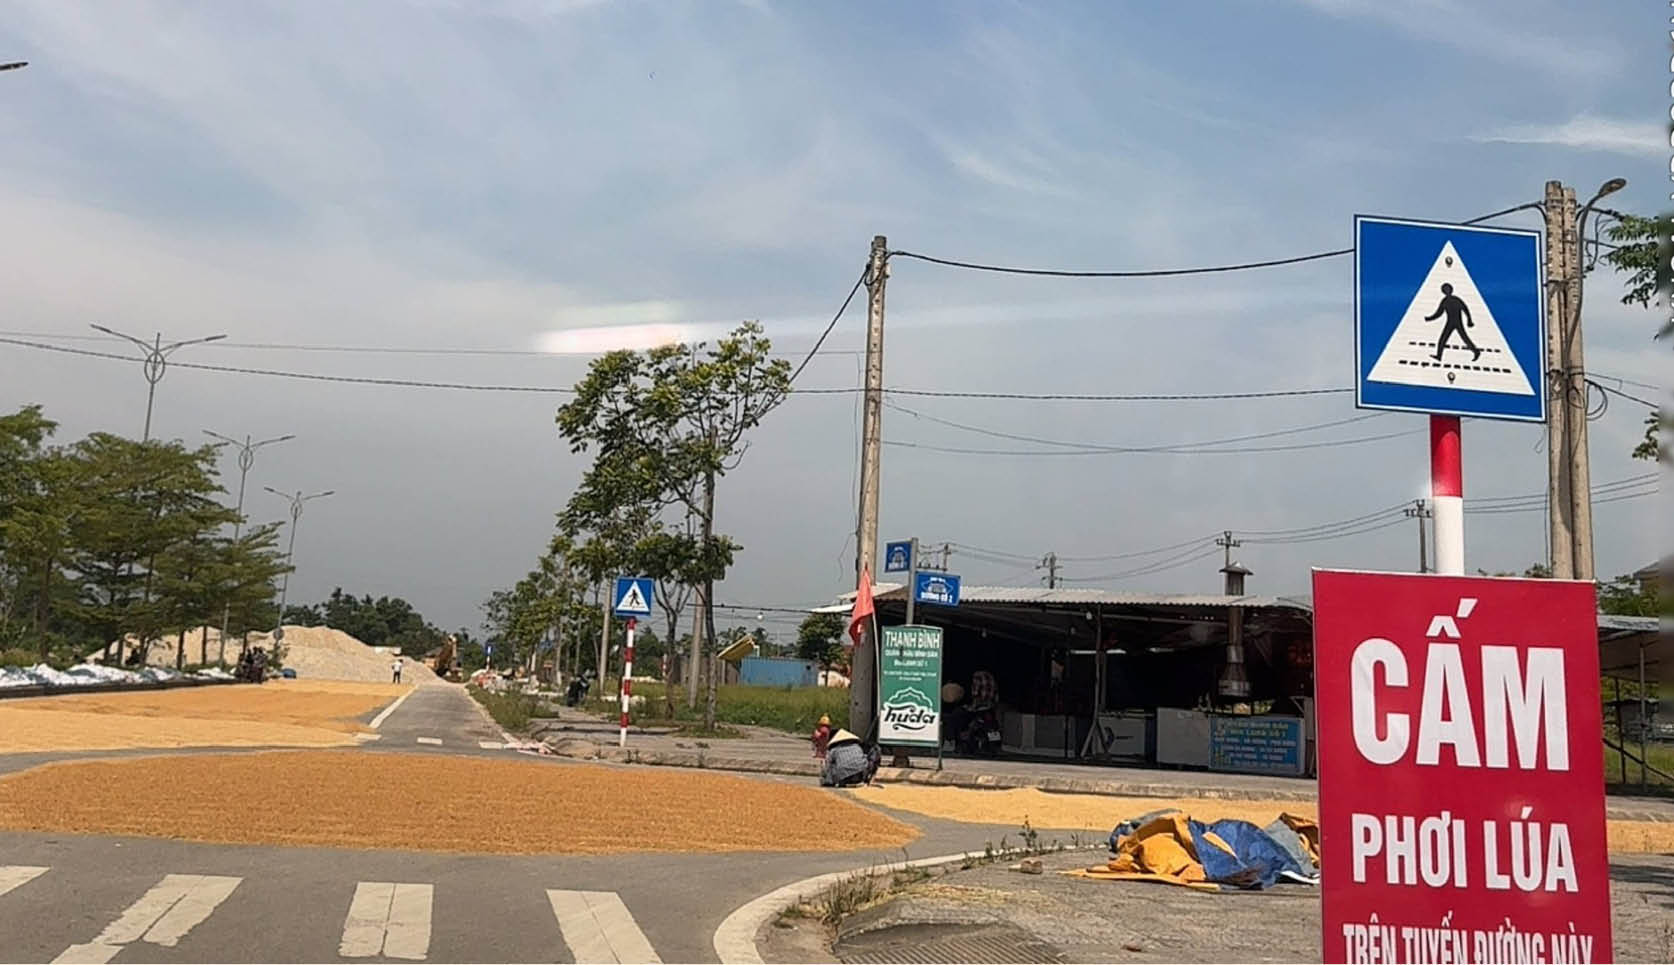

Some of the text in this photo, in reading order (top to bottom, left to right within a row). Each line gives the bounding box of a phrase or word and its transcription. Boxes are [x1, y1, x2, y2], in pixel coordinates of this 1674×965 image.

[885, 629, 940, 649] THANH BÌNH
[1351, 598, 1570, 771] CẤM
[1352, 806, 1579, 892] PHƠI LÚA
[1343, 910, 1593, 964] TRÊN TUYẾN ĐƯỜNG NÀY
